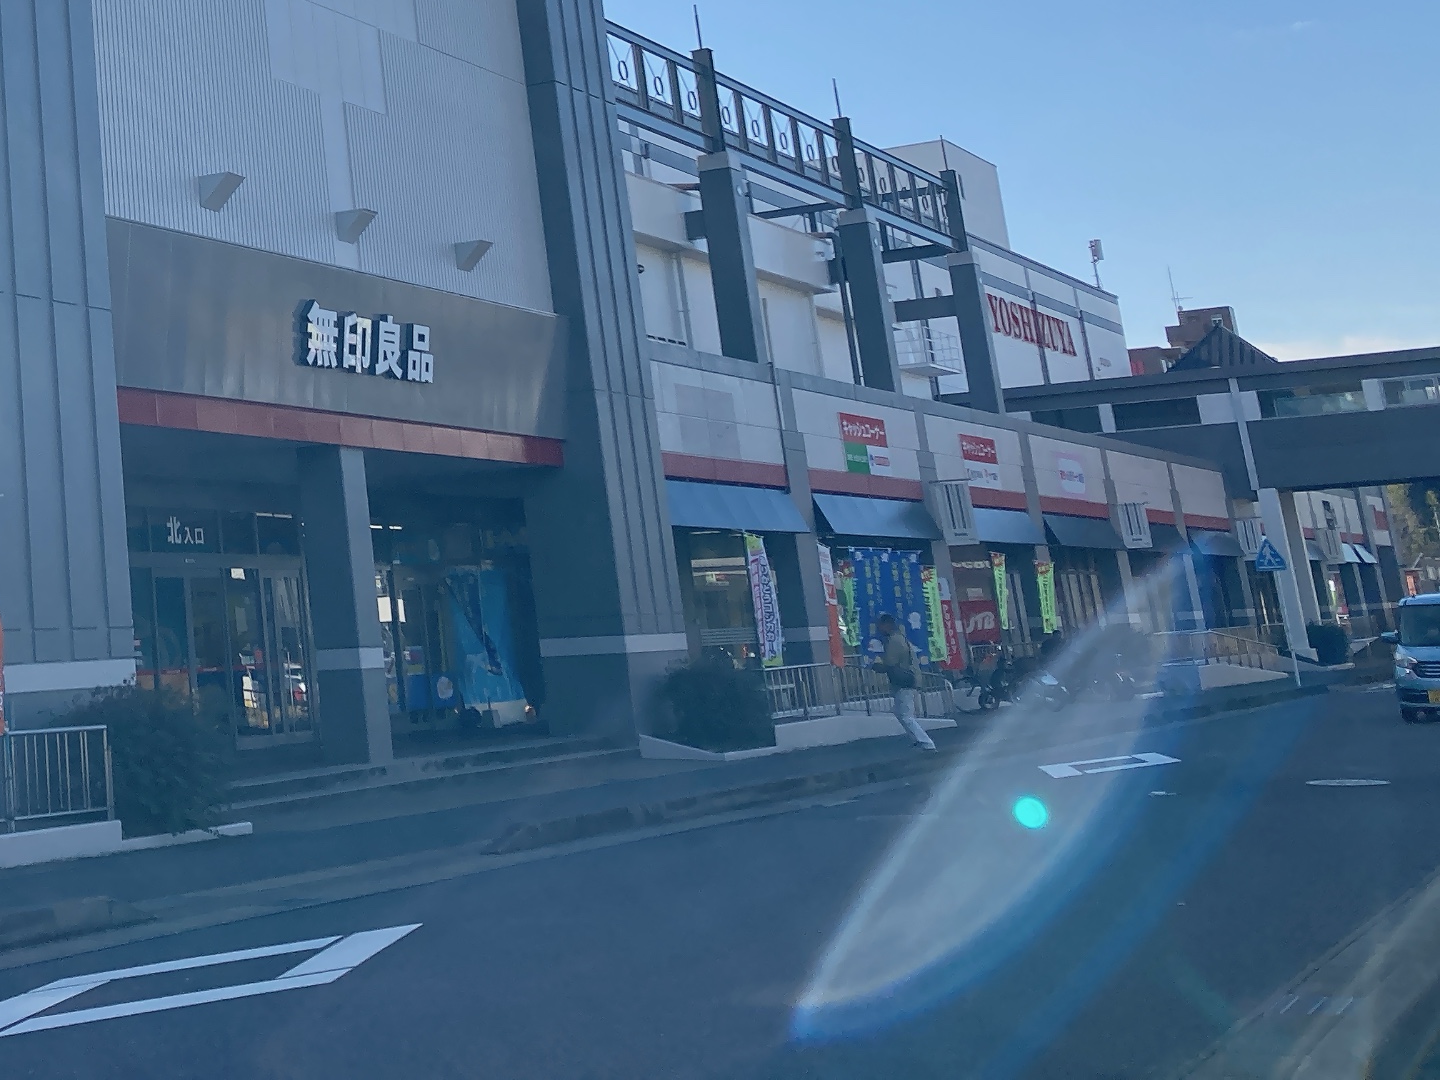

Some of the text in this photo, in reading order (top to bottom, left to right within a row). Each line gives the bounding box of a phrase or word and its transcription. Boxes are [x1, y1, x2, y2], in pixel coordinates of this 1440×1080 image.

[304, 300, 434, 384] 無印良品
[986, 292, 1078, 357] YOSHIZUYA
[166, 516, 205, 544] 北入口
[965, 611, 995, 634] JTB
